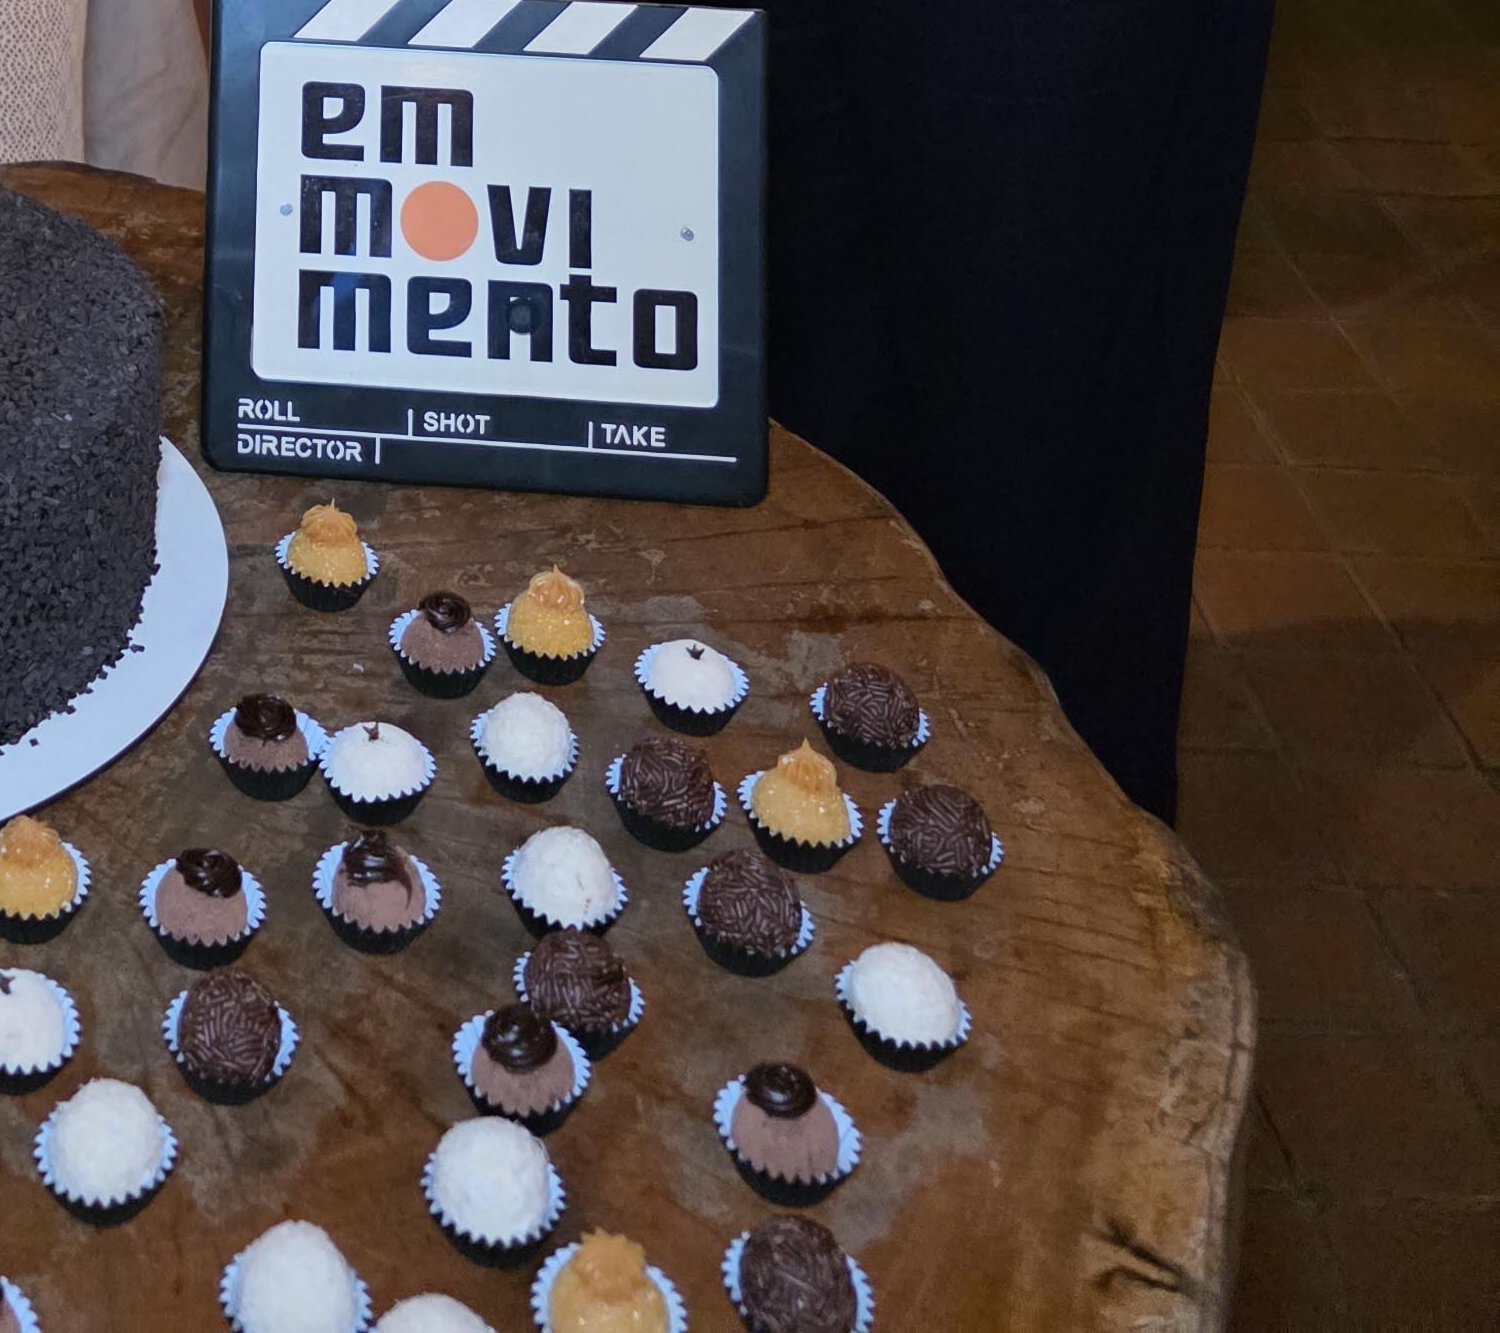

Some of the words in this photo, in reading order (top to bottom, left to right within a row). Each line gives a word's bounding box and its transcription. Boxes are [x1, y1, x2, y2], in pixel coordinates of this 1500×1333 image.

[301, 81, 473, 167] em
[297, 269, 699, 371] mento
[237, 397, 300, 422] ROLL
[423, 411, 491, 434] SHOT
[601, 423, 666, 448] TAKE
[237, 433, 363, 462] DIRECTOR
